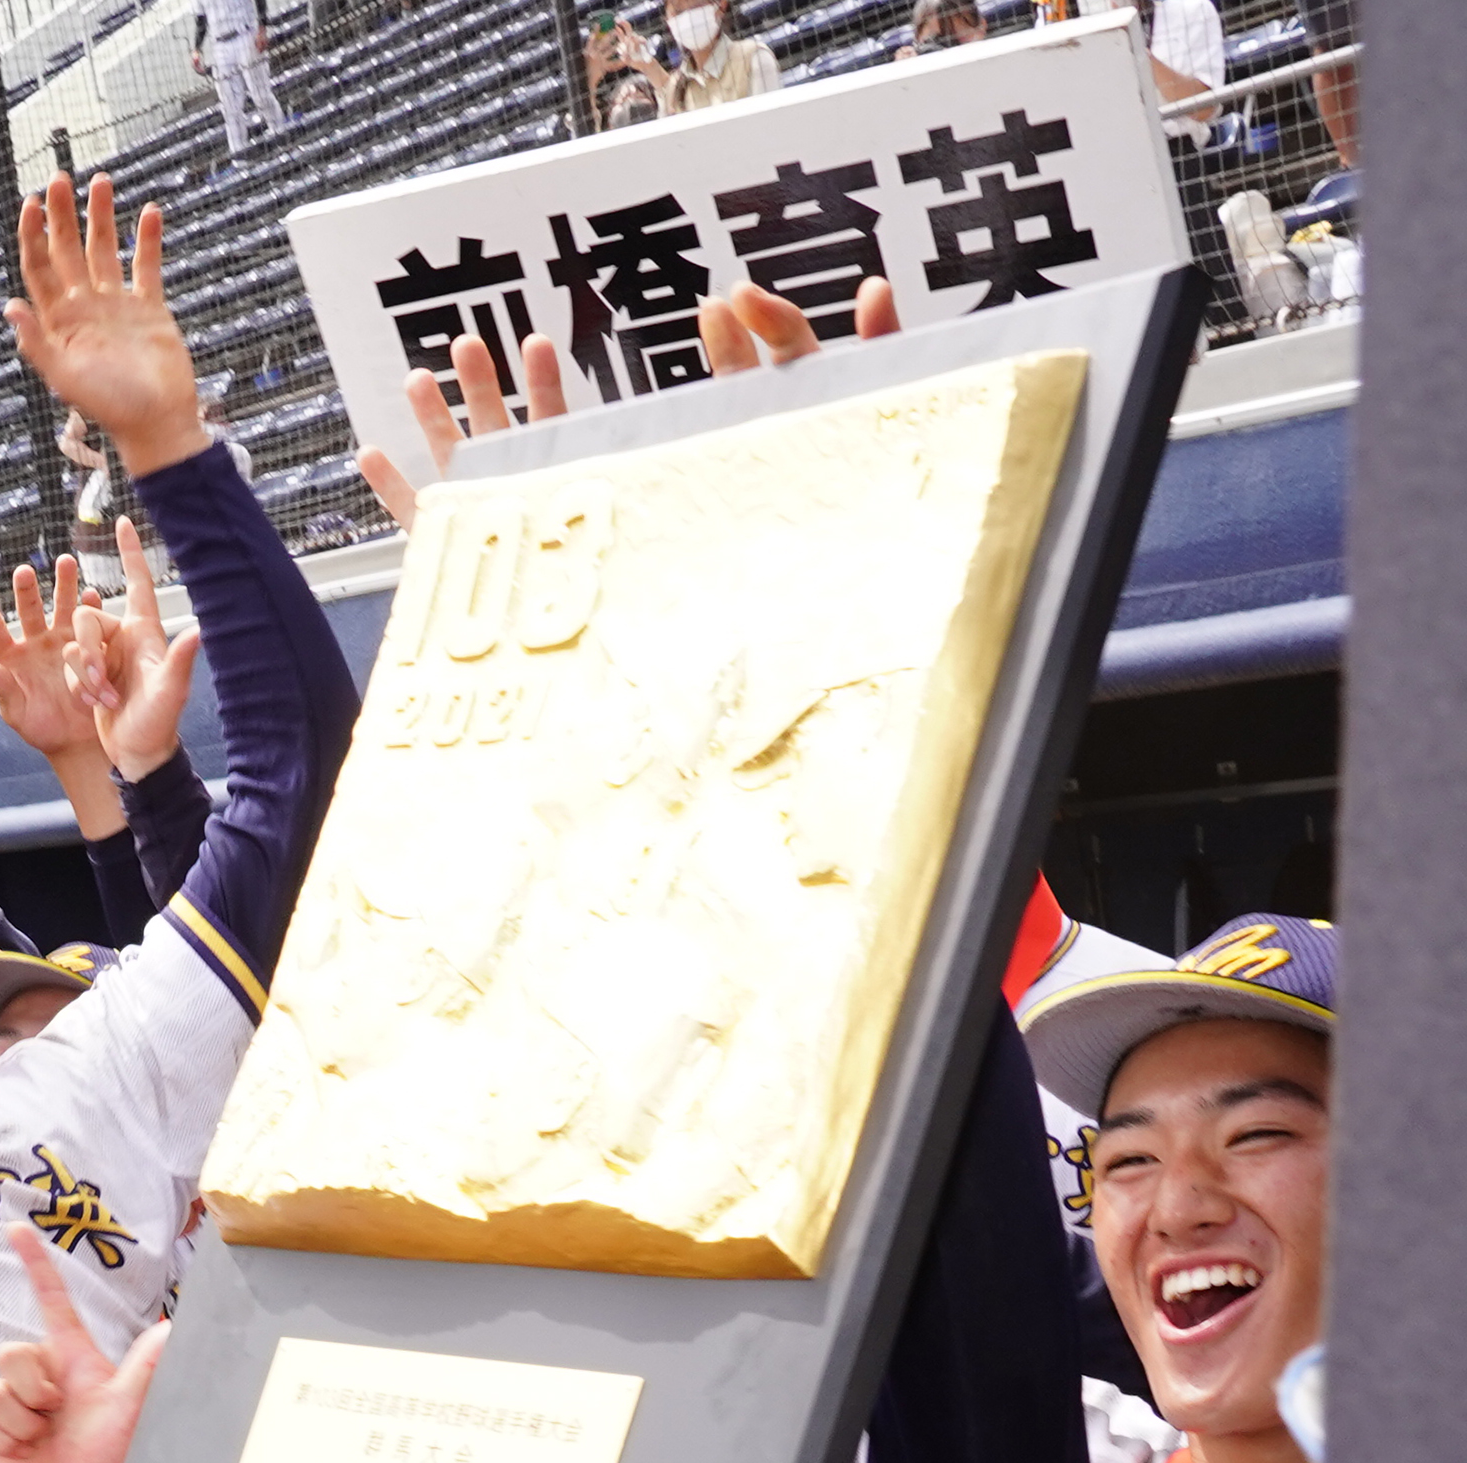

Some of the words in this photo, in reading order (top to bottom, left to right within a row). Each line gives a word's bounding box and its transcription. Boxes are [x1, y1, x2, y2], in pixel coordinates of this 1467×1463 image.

[375, 108, 1098, 438] 前橋育英
[384, 680, 555, 750] 2021
